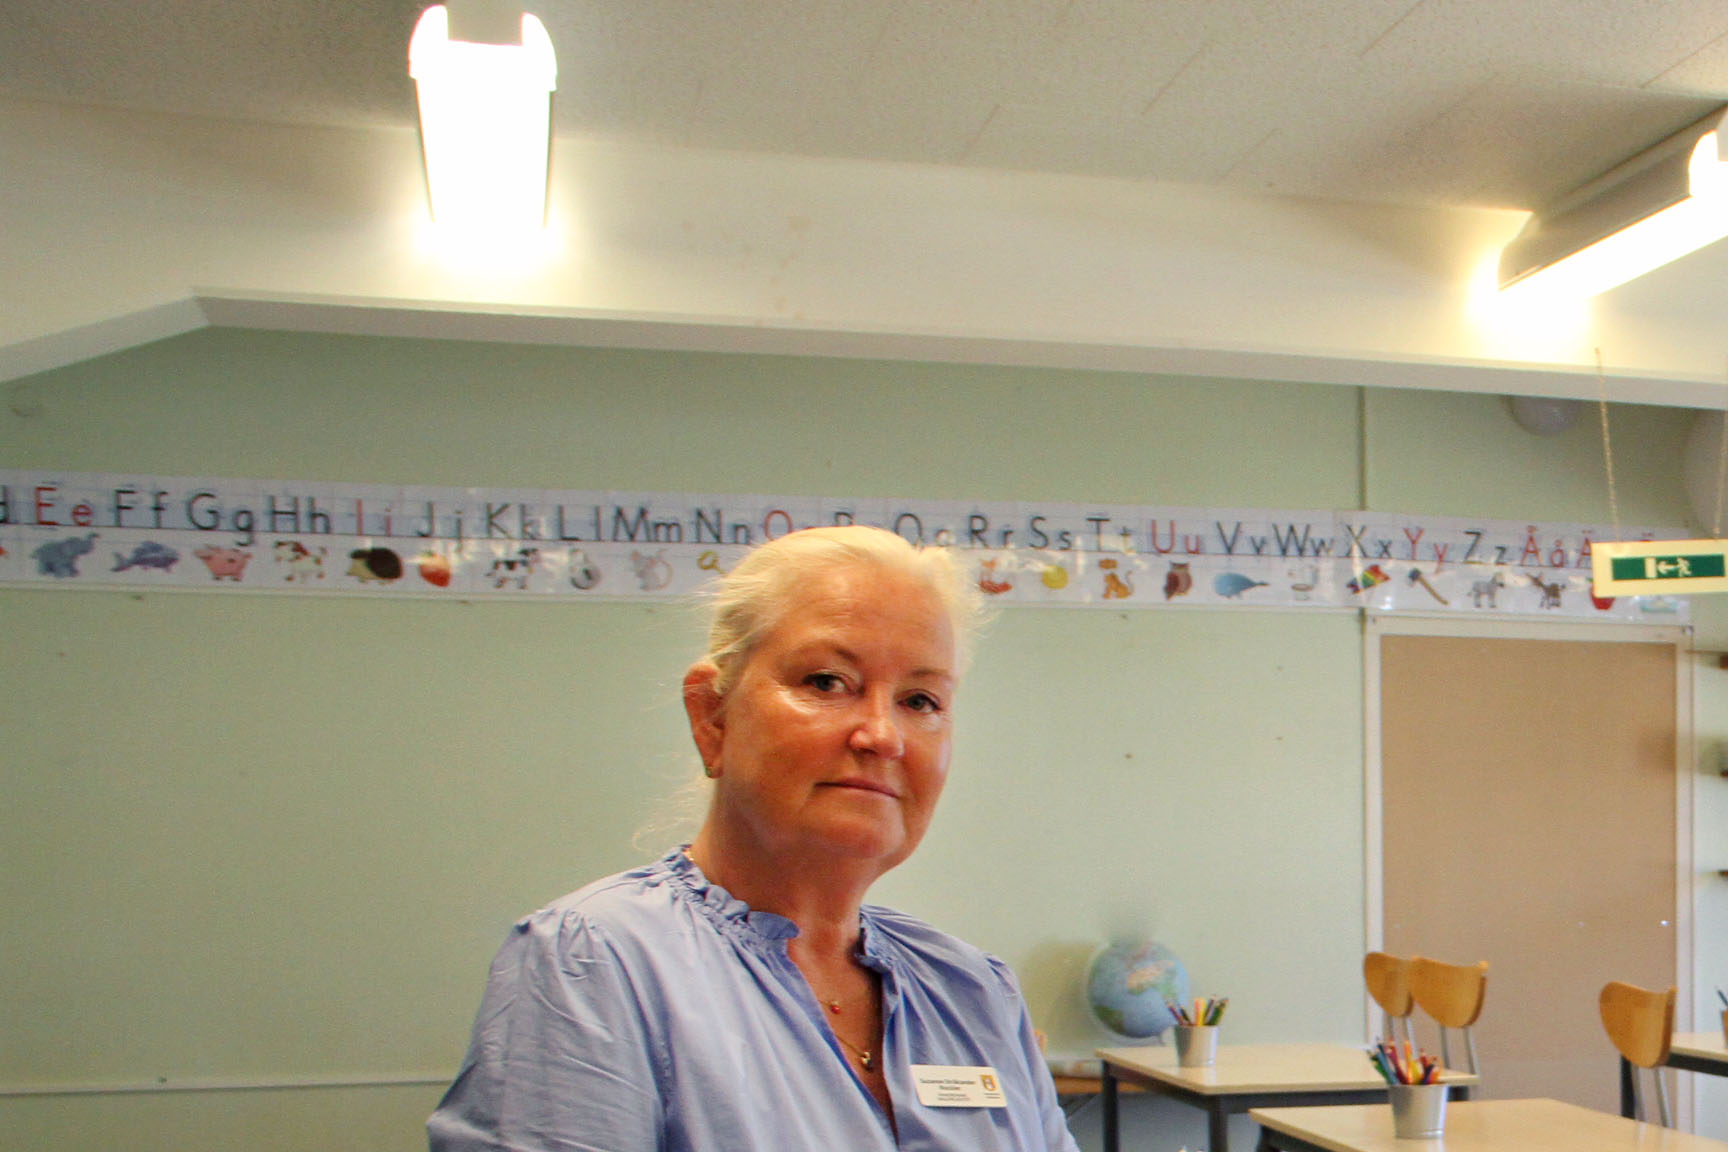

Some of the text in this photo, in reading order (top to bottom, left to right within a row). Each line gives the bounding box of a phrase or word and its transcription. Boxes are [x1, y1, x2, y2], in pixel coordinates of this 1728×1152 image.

[35, 486, 93, 527] Ee
[114, 489, 169, 528] Ff
[187, 492, 255, 546] Gg
[267, 495, 331, 534] Hh
[415, 501, 463, 553] Jj
[487, 503, 539, 539] Kk
[612, 505, 683, 542] Mm
[696, 508, 751, 544] Nn
[968, 514, 1014, 550] Rr
[1029, 515, 1073, 551] Ss
[1086, 517, 1134, 555] Tt
[1151, 519, 1201, 554] Uu
[1215, 520, 1267, 555] Vv
[1272, 523, 1335, 557] Ww
[1345, 525, 1393, 558] Xx
[1402, 527, 1449, 574] Yy
[1463, 529, 1507, 566] Zz
[1520, 525, 1566, 568] Åå
